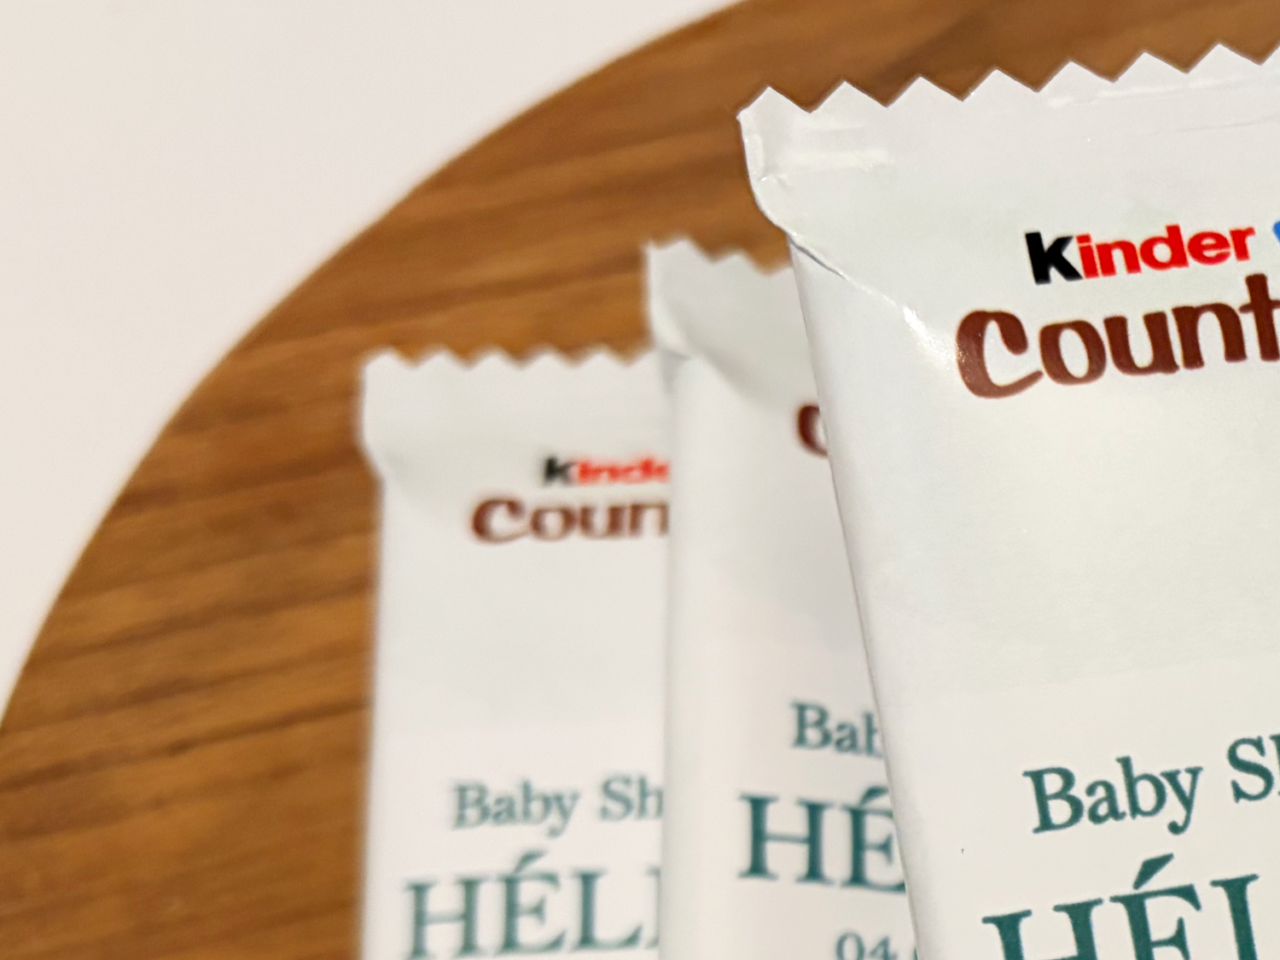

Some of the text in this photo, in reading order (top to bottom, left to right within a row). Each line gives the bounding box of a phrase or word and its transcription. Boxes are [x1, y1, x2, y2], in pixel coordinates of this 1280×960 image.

[1024, 223, 1256, 285] Kinder
[455, 780, 580, 838] Baby
[1023, 756, 1203, 835] Baby
